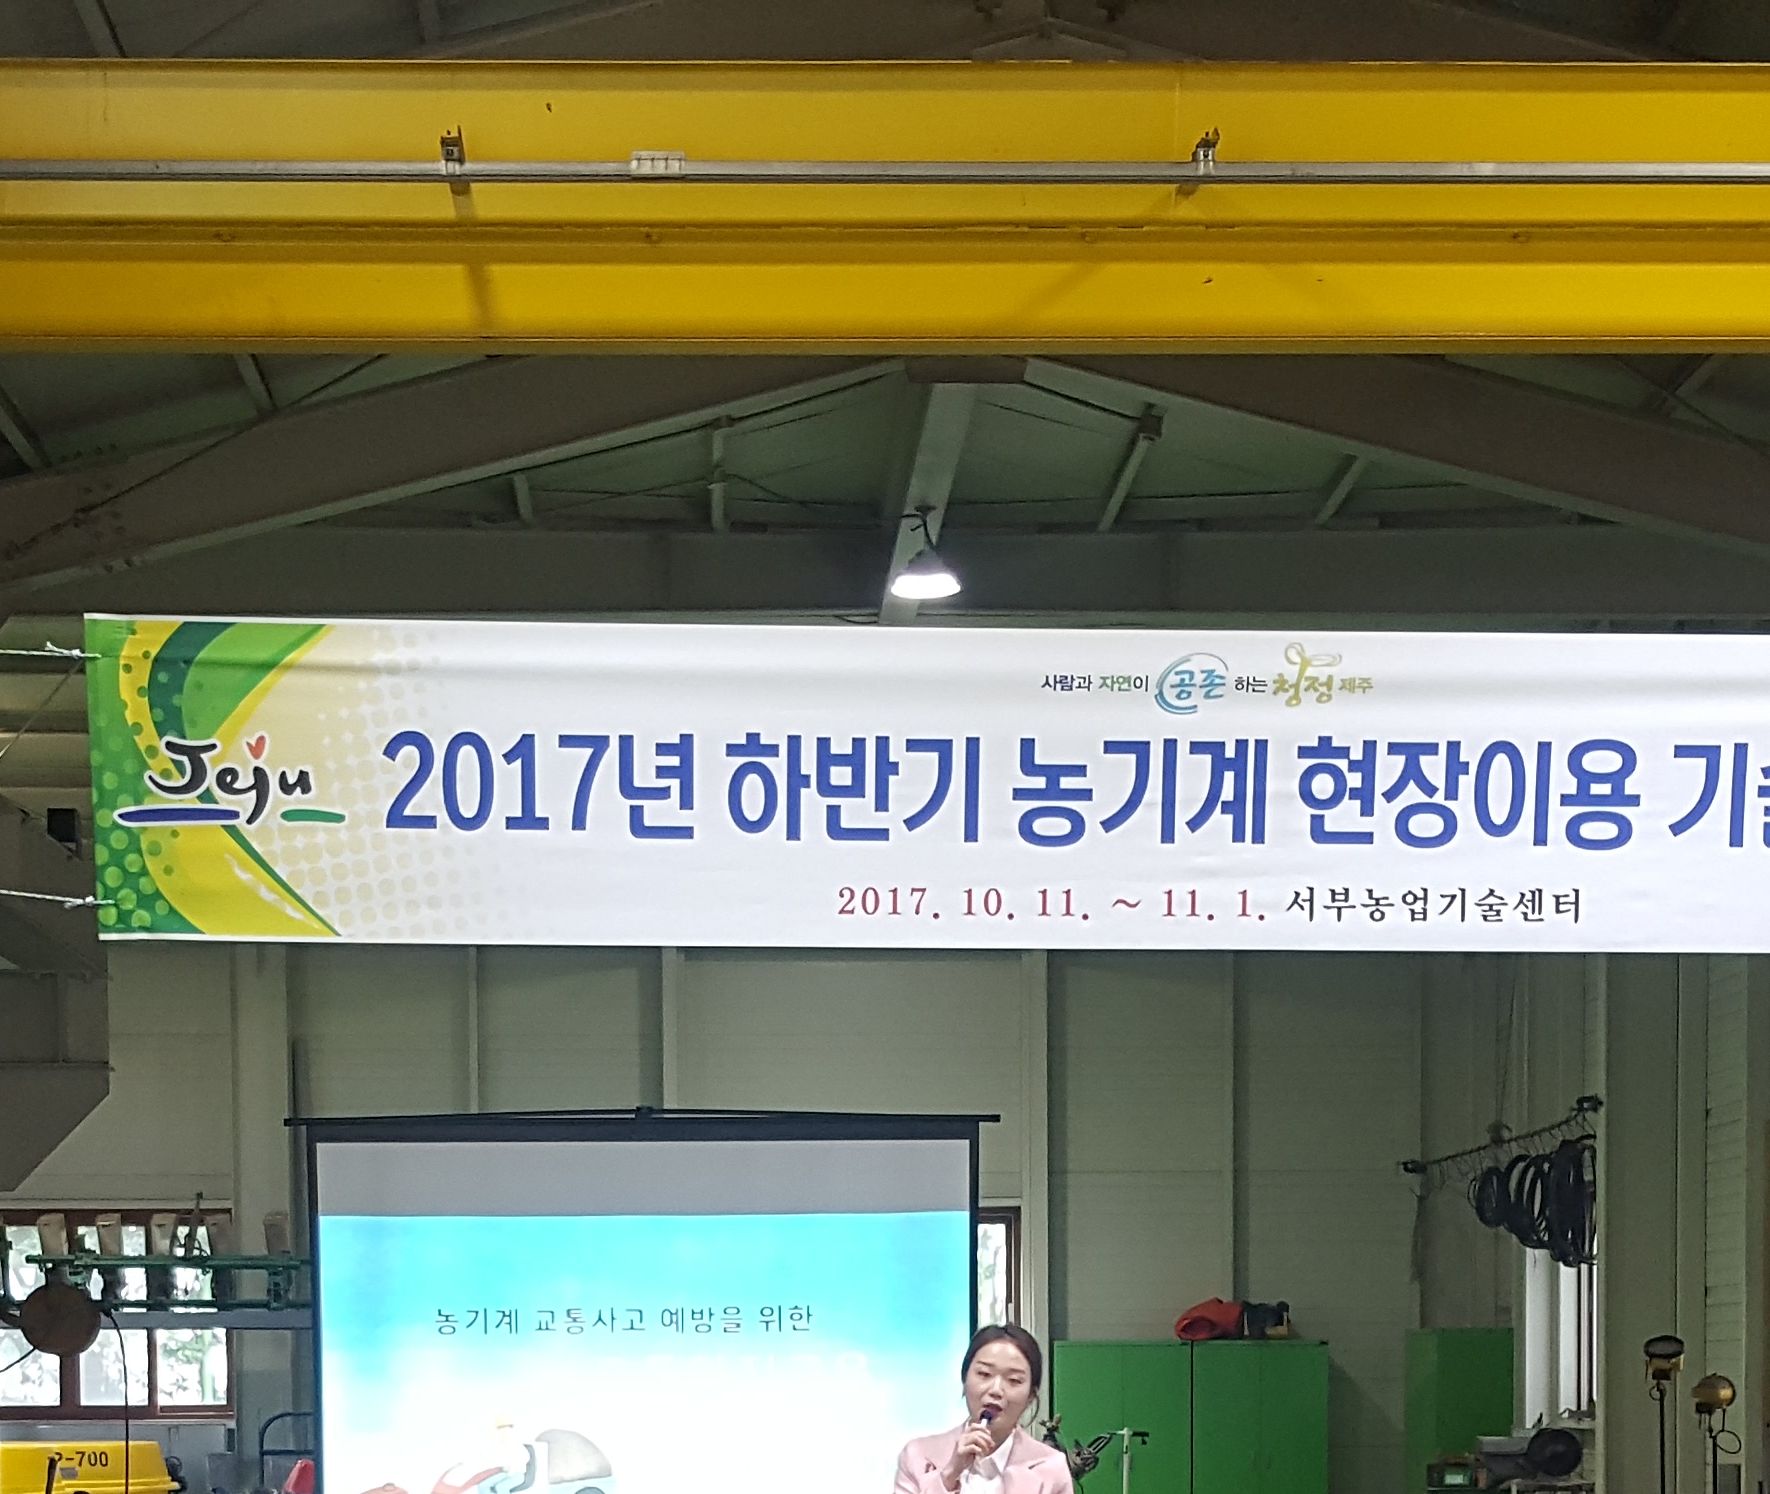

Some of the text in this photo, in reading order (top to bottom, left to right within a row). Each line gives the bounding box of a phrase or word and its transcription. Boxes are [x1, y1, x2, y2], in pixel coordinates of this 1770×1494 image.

[1040, 643, 1374, 707] 사람과 자연이 공존 하는 청정 제주
[147, 734, 312, 824] Jeju
[382, 731, 695, 840] 2017년
[726, 732, 981, 842] 하반기
[1012, 737, 1269, 847] 농기계
[1296, 736, 1642, 850] 현장이용
[838, 887, 940, 920] 2017.
[963, 888, 1015, 921] 10.
[1039, 888, 1090, 921] 11.
[1163, 889, 1215, 922] 11.
[1237, 889, 1265, 922] 1.
[1285, 886, 1580, 924] 서부농업기술센터
[435, 1304, 814, 1335] 농기계 교통사고 예방을 위한
